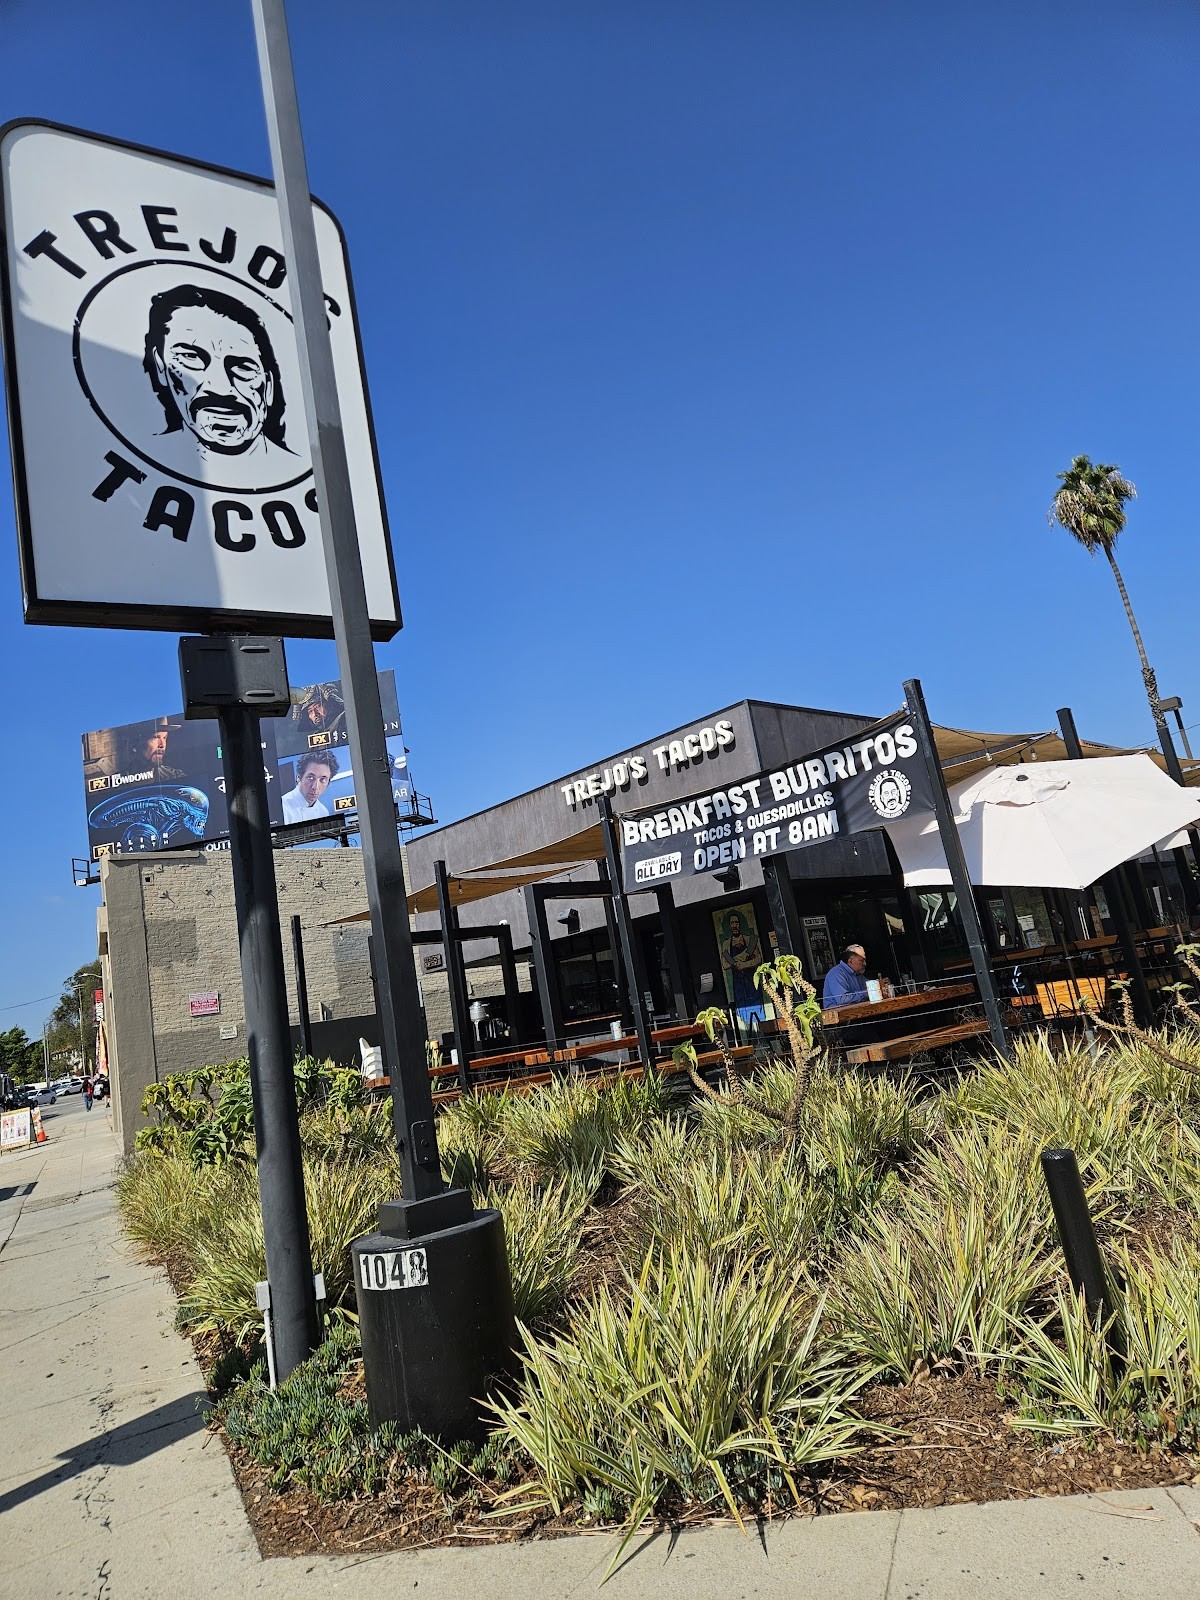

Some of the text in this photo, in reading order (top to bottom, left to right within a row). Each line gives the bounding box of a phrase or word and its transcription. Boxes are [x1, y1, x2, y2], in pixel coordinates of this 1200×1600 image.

[23, 204, 341, 331] TREJO
[111, 770, 154, 788] LOWDOWN
[561, 720, 735, 806] TREJO'S TACOS
[624, 724, 918, 846] BREAKFAST BURRITOS
[890, 769, 912, 791] TACOS
[693, 790, 834, 846] TACOS & QUESADILLAS
[693, 809, 839, 871] OPEN AT 8AM
[637, 859, 679, 880] ALL DAY
[363, 1251, 427, 1289] 1048
